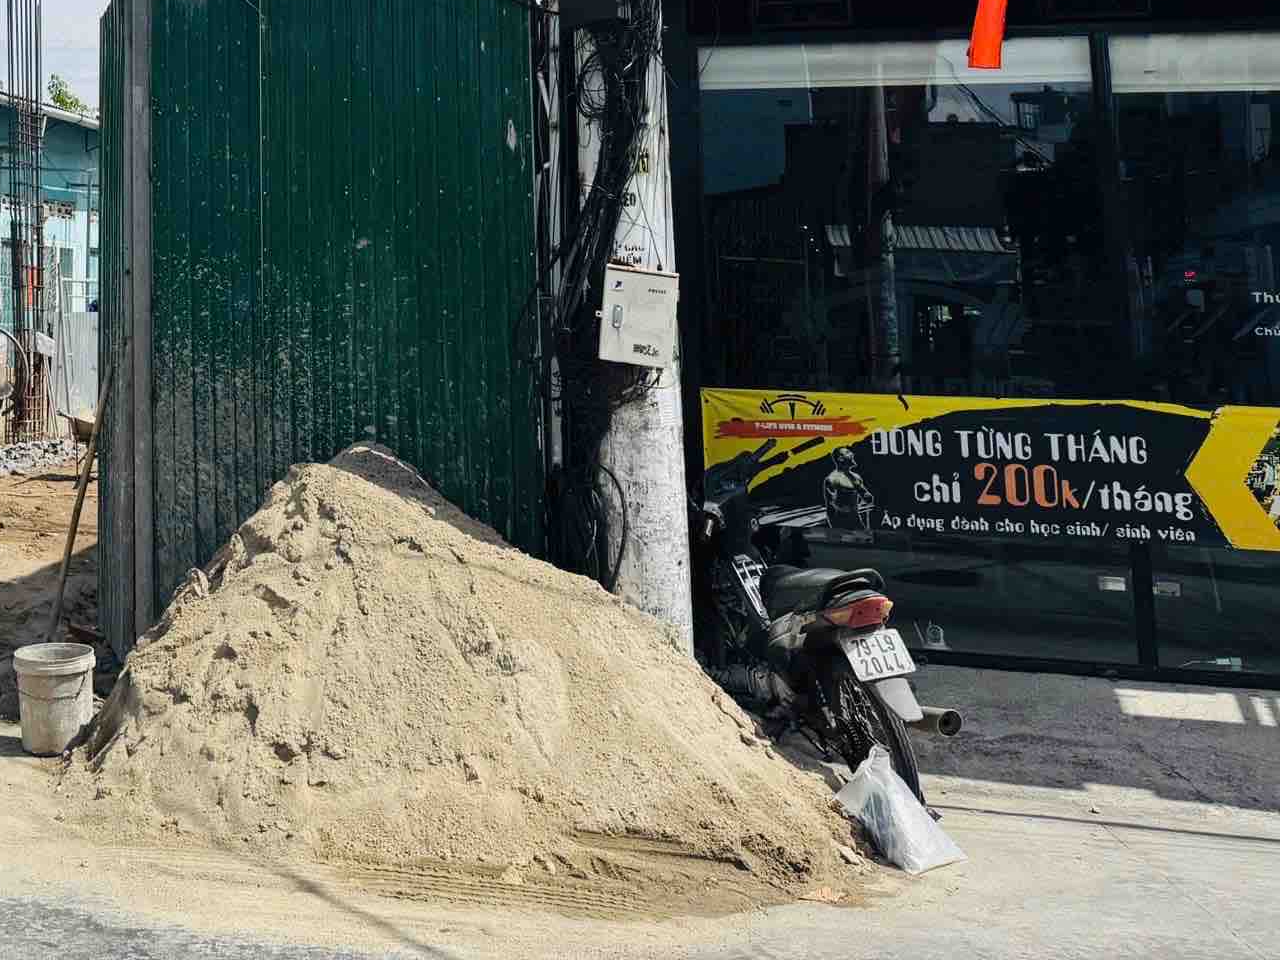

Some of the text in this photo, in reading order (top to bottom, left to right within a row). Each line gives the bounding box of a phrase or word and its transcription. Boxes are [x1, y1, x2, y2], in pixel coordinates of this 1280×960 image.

[953, 425, 1032, 461] TỪNG
[1044, 430, 1148, 464] THÁNG
[914, 472, 961, 504] chỉ
[906, 513, 945, 532] dụng
[995, 518, 1025, 533] cho
[1030, 519, 1061, 537] học
[1116, 524, 1151, 539] sinh
[1157, 526, 1196, 541] viên
[861, 653, 906, 676] 2044
